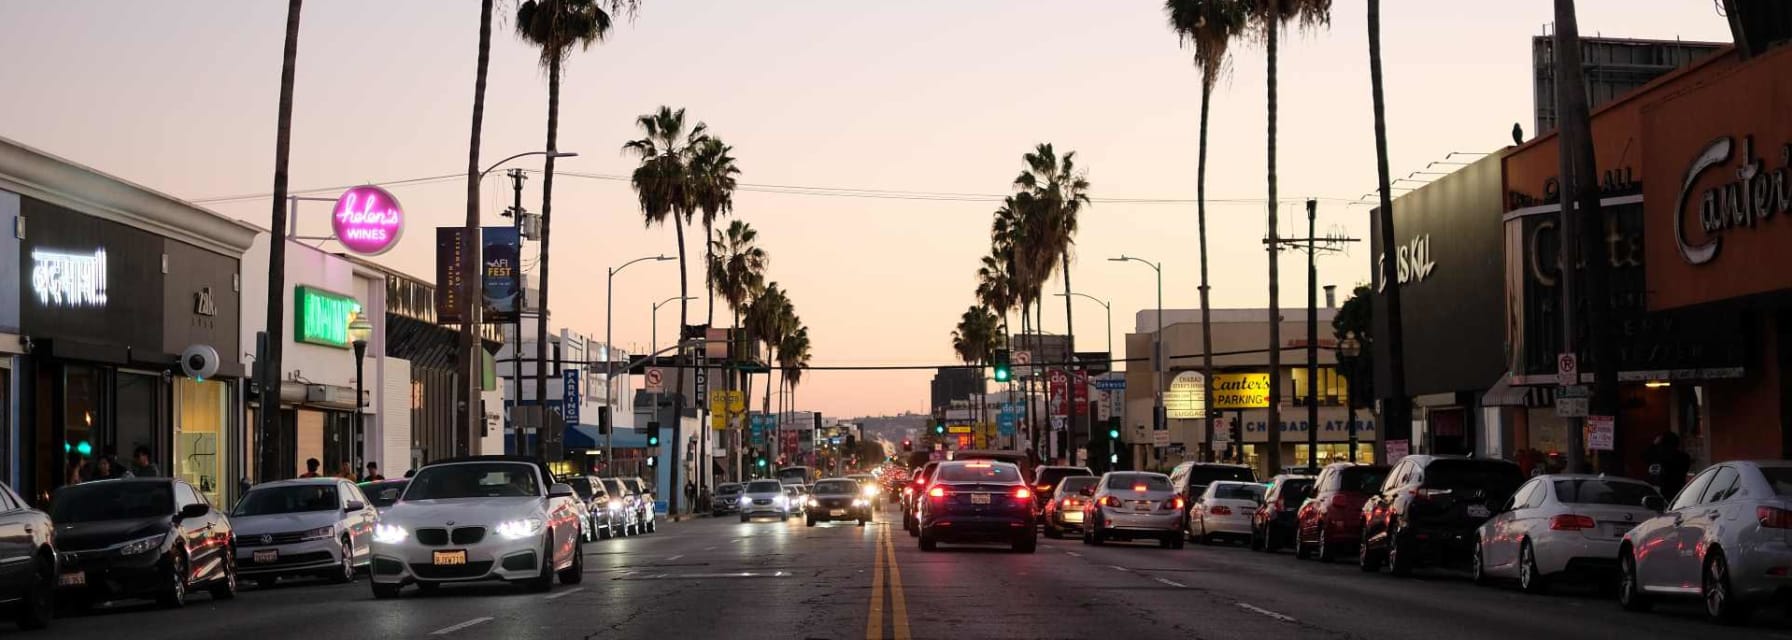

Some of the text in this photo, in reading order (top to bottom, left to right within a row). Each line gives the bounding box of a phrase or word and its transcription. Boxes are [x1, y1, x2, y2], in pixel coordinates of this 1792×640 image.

[337, 192, 399, 225] helen's
[347, 229, 387, 240] WINES
[493, 258, 508, 267] AFI
[488, 267, 512, 277] FEST
[567, 371, 577, 415] PARKING
[1218, 395, 1263, 405] PARKING
